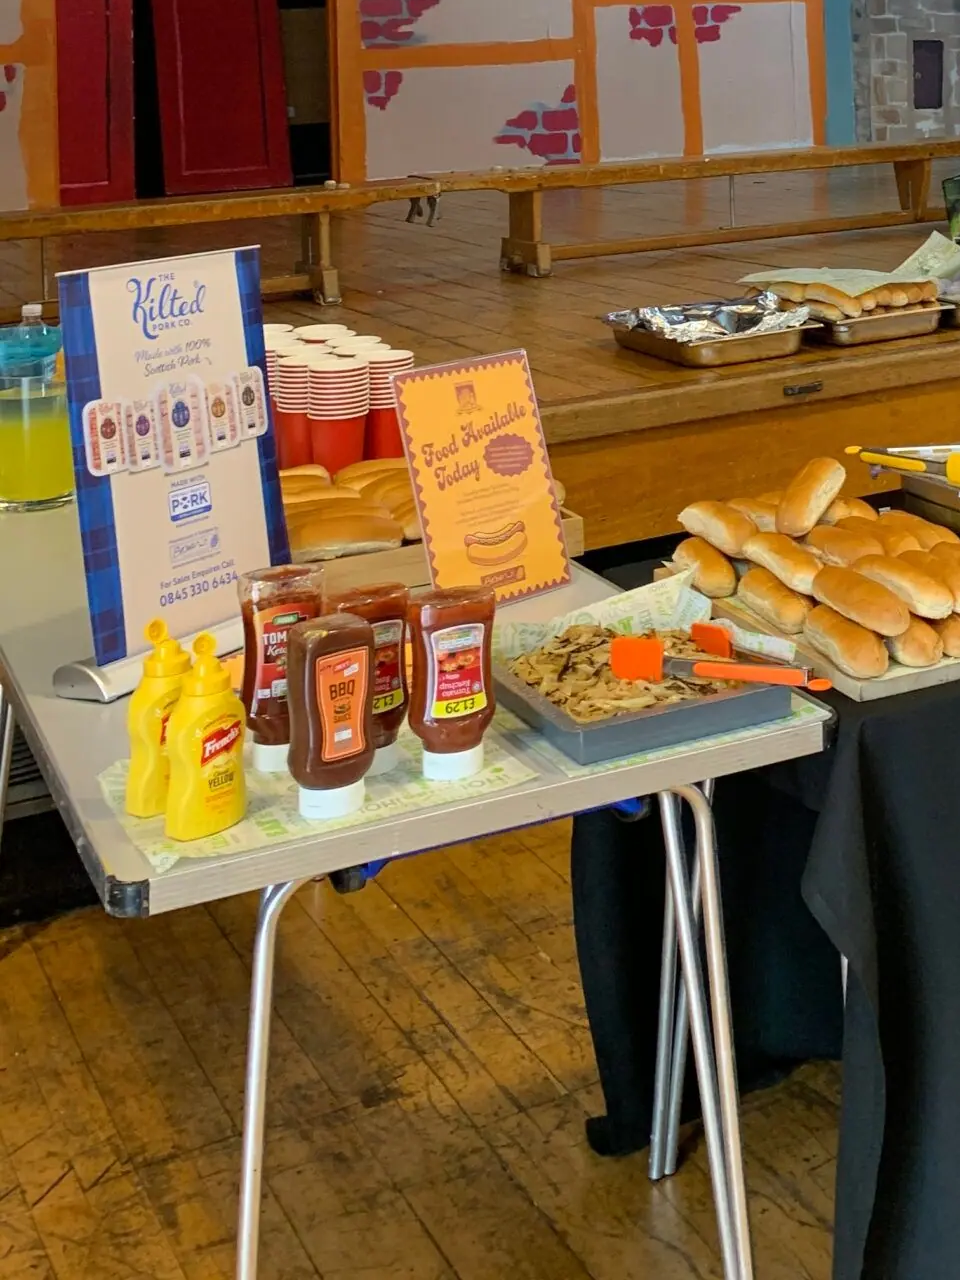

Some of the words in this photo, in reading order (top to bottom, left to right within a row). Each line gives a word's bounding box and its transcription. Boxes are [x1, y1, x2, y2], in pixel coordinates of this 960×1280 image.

[158, 273, 175, 281] THE
[126, 278, 206, 340] Kilted
[152, 321, 176, 331] PORK
[185, 338, 211, 352] 100%
[421, 434, 459, 468] Food
[461, 401, 527, 448] Available
[434, 459, 480, 492] Today
[159, 588, 188, 607] 0845
[190, 580, 209, 597] 330
[212, 570, 239, 589] 6434
[160, 581, 172, 590] For
[262, 631, 287, 645] TOM
[329, 679, 355, 700] BBQ
